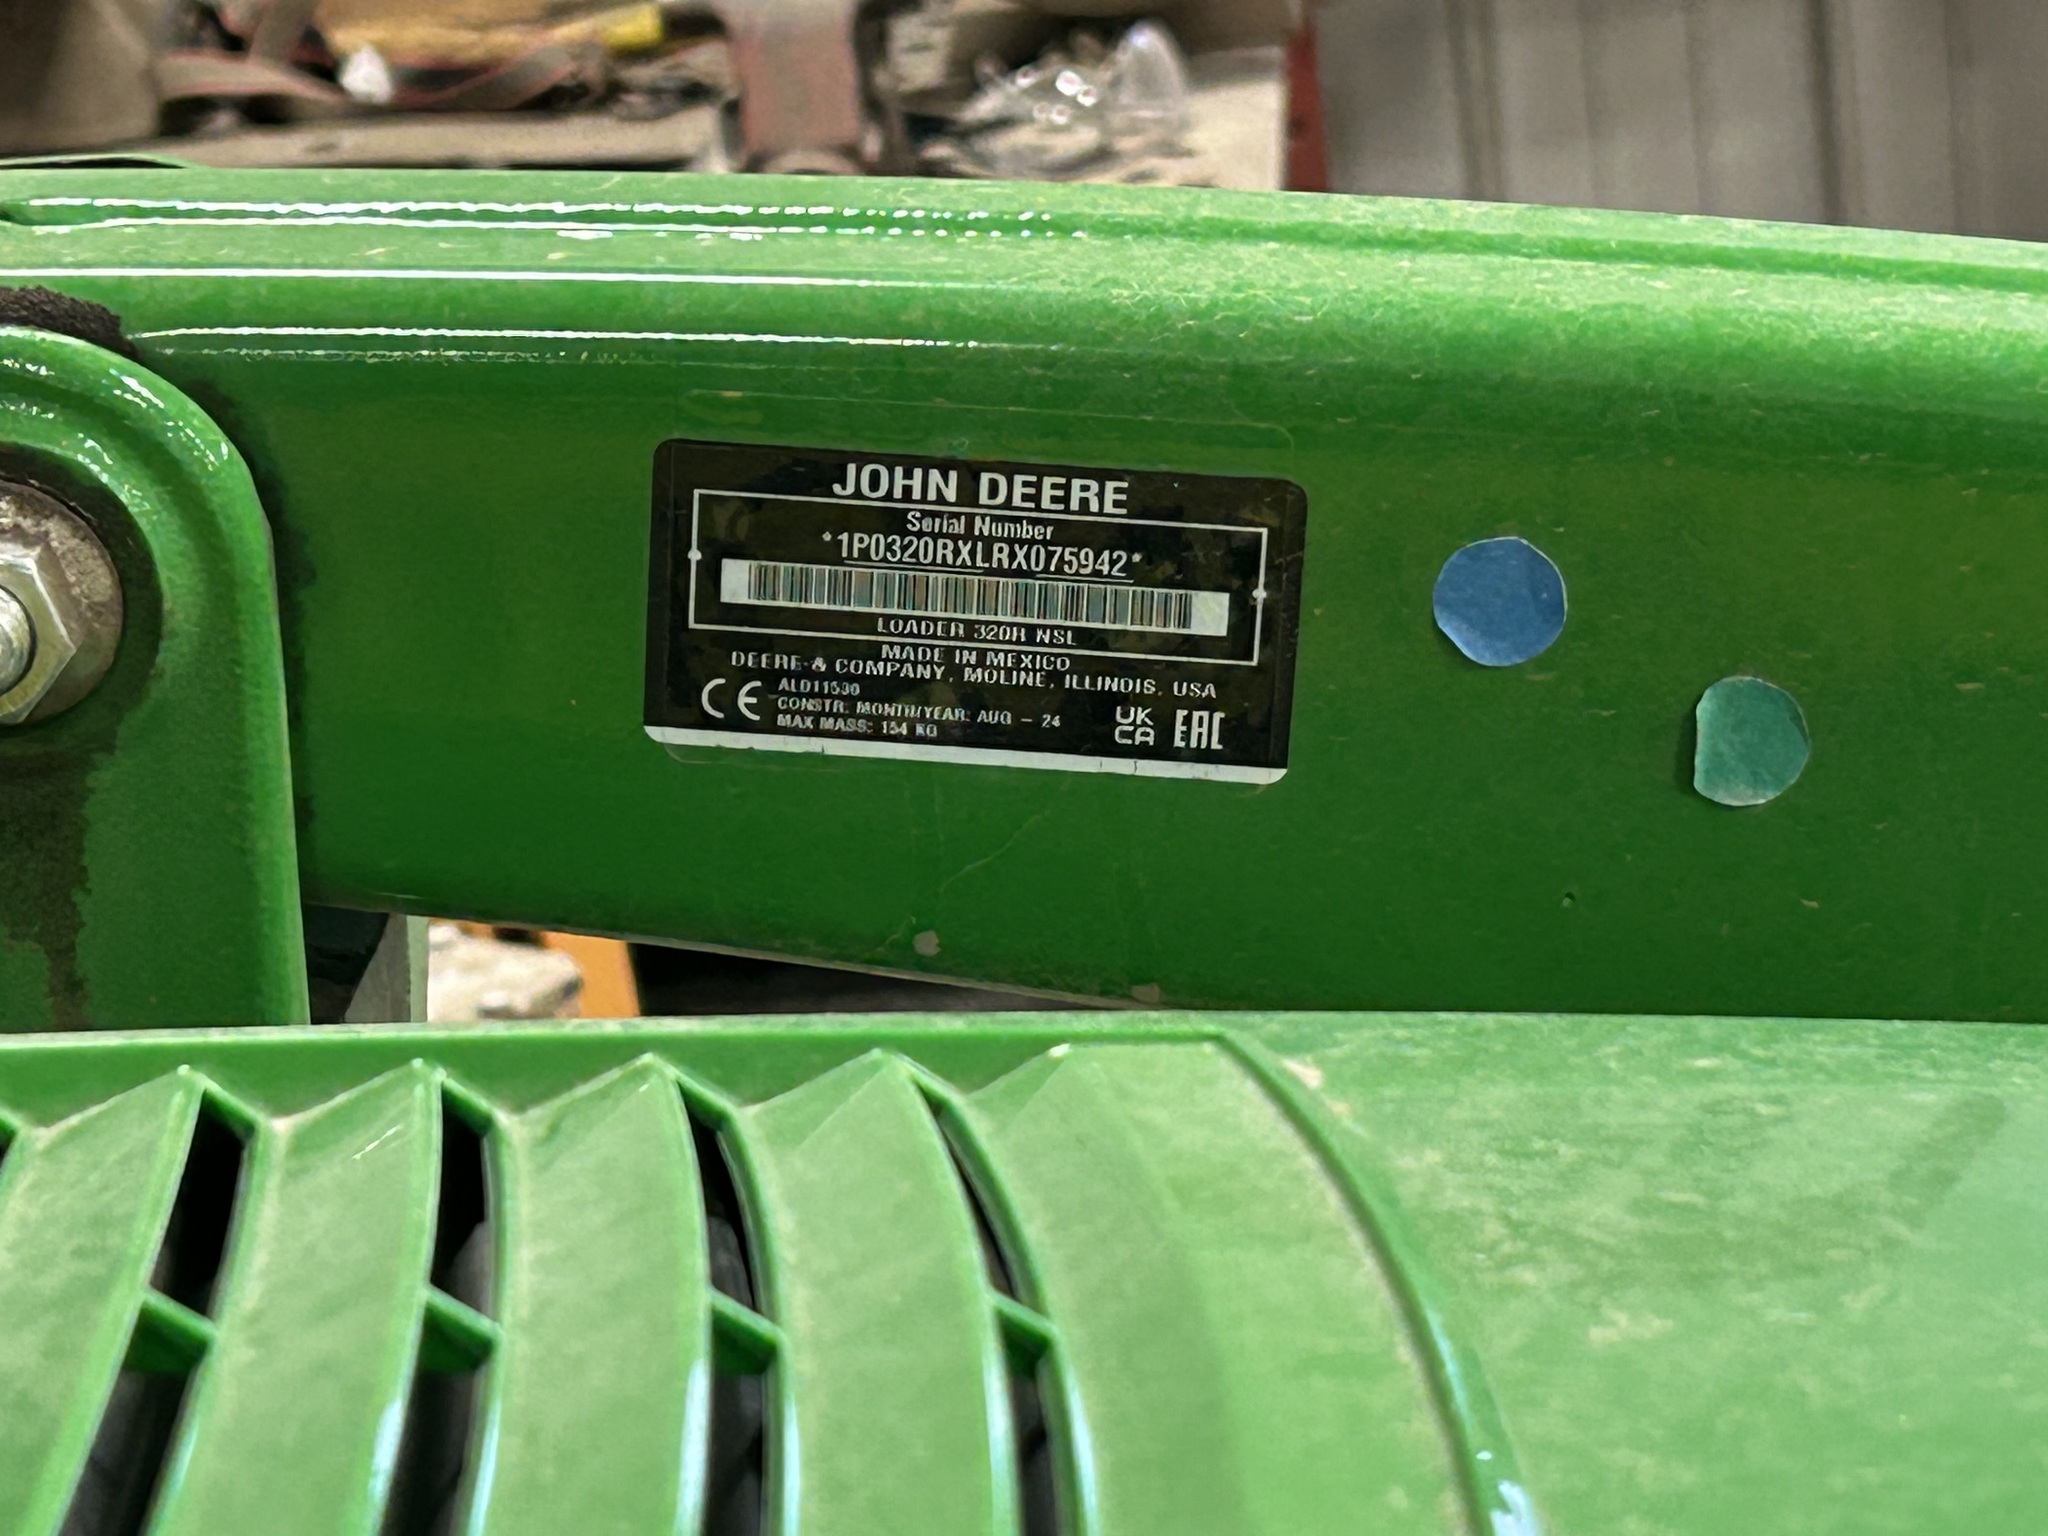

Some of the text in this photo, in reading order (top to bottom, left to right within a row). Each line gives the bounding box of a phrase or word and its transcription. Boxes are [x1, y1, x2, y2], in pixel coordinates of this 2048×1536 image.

[832, 463, 1129, 515] JOHN DEERE
[906, 510, 1054, 541] Serial Number
[877, 617, 965, 638] LOADER
[1036, 628, 1077, 646] NSL
[881, 644, 1071, 672] MADE IN MEXICO
[731, 651, 802, 671] DEERE
[811, 656, 827, 672] &
[1173, 681, 1217, 698] USA
[701, 677, 762, 721] CE
[977, 709, 1013, 725] AUG
[1041, 714, 1061, 729] 24
[1115, 705, 1154, 726] UK
[1114, 725, 1156, 746] CA
